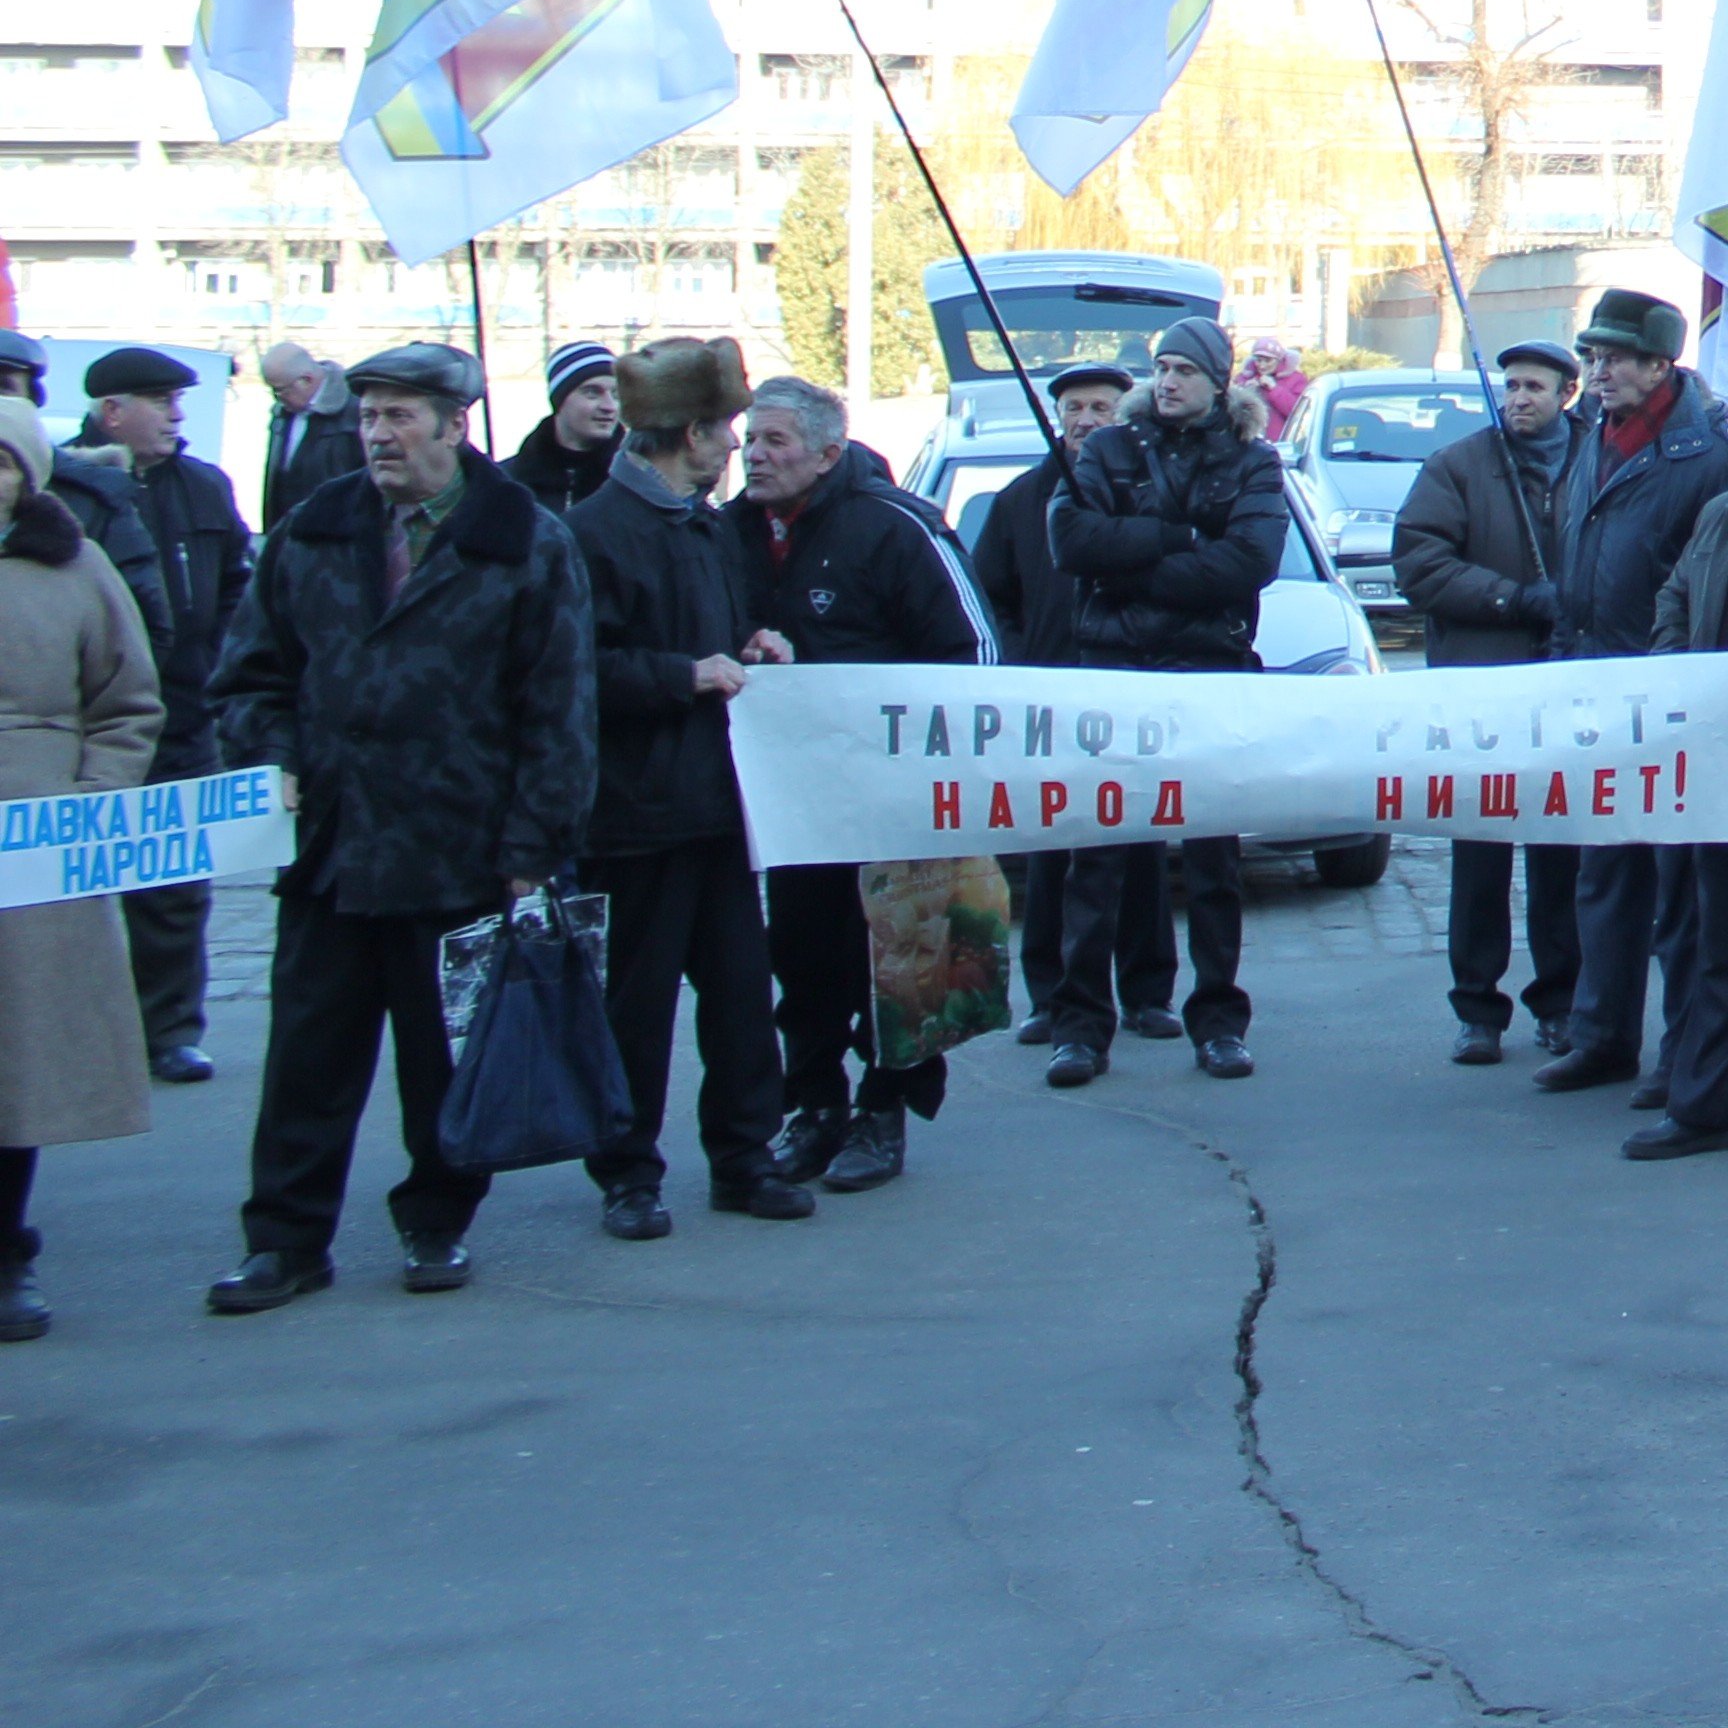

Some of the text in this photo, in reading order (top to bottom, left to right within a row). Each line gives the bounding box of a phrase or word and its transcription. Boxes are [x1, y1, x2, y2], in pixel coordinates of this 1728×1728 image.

[141, 784, 187, 834] НА
[199, 771, 271, 825] ШЕЕ
[932, 750, 1687, 830] НАРОД НИЩАЕТ!
[62, 828, 215, 894] НАРОДА
